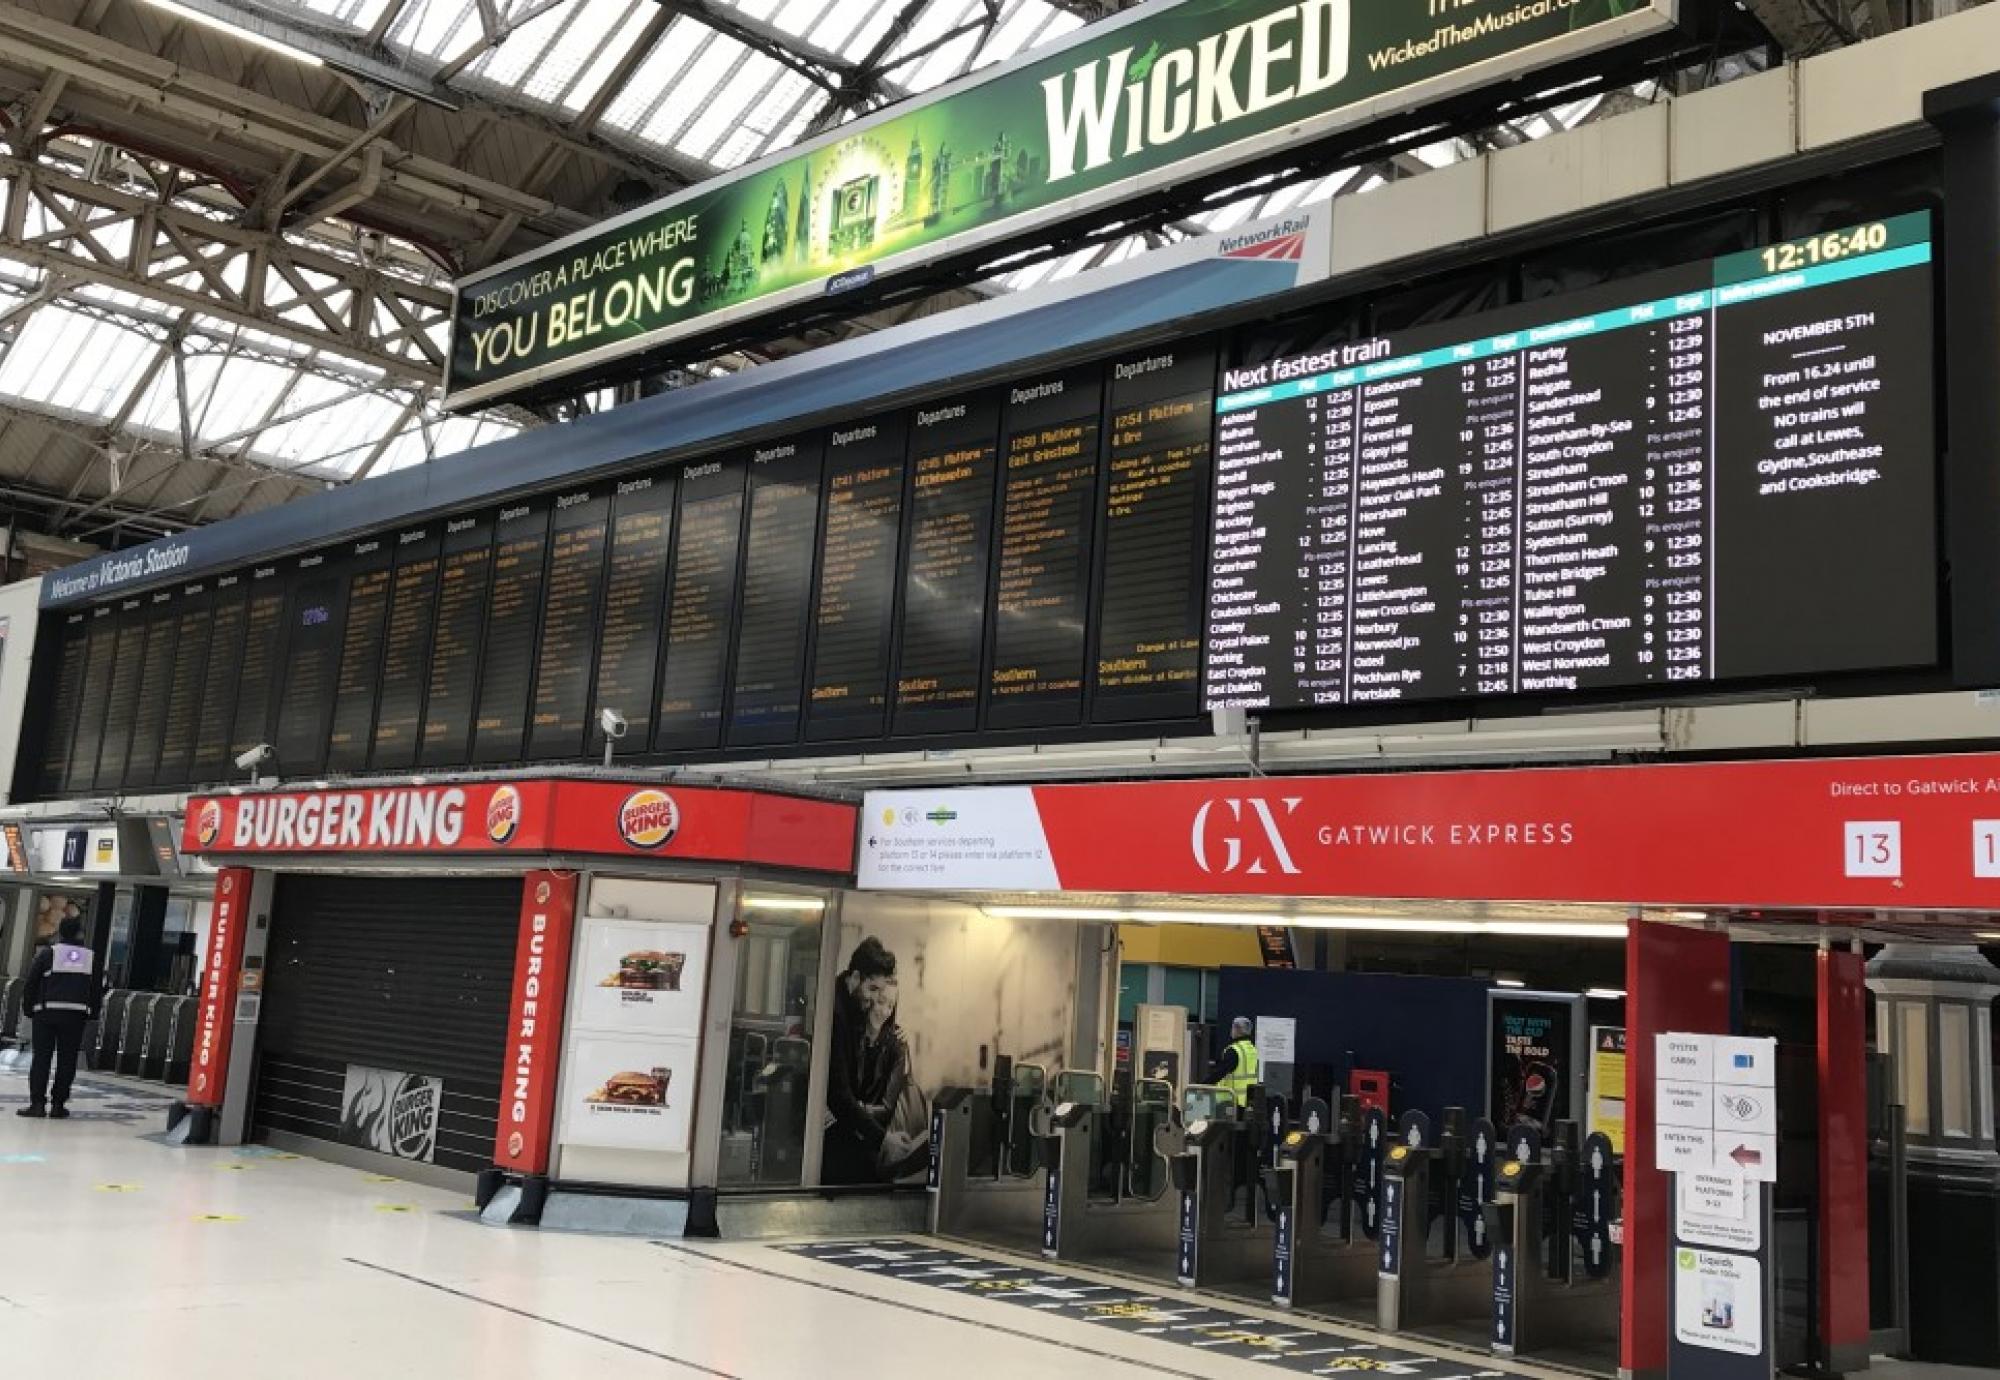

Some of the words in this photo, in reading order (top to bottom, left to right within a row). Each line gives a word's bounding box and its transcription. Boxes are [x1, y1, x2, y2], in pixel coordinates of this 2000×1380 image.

[1762, 223, 1887, 272] 12:16:40
[474, 273, 553, 319] DISCOVER
[554, 268, 566, 288] A
[572, 240, 625, 283] PLACE
[630, 214, 698, 258] WHERE
[472, 311, 537, 372] YOU
[547, 257, 695, 347] BELONG
[1763, 317, 1843, 346] NOVEMBER
[1846, 312, 1875, 331] 5TH
[1223, 368, 1267, 392] Next
[1272, 349, 1338, 379] fastest
[1342, 337, 1391, 363] train
[1529, 347, 1567, 362] Purley
[1115, 354, 1173, 380] Departures
[1763, 369, 1800, 388] From
[1803, 360, 1841, 380] 16.24
[1844, 355, 1876, 374] until
[1011, 380, 1063, 404] Departures
[1528, 388, 1601, 414] Sanderstead
[1759, 396, 1781, 410] the
[1783, 390, 1810, 405] end
[1813, 387, 1829, 400] of
[1830, 379, 1881, 397] service
[1364, 397, 1399, 414] Epsom
[1773, 413, 1798, 429] NO
[1799, 405, 1839, 424] trains
[1842, 401, 1865, 417] will
[918, 405, 966, 427] Departures
[833, 426, 877, 447] Departures
[1774, 433, 1798, 450] call
[1800, 432, 1815, 445] at
[1817, 425, 1864, 443] Lewes,
[1527, 449, 1562, 464] South
[1562, 440, 1613, 458] Croydon
[1360, 473, 1410, 492] Haywards
[1411, 468, 1444, 482] Heath
[1526, 463, 1588, 481] Streatham
[1759, 479, 1786, 495] and
[1788, 467, 1881, 491] Cooksbridge.
[1360, 494, 1392, 507] Honor
[1393, 488, 1415, 501] Oak
[1416, 484, 1442, 498] Park
[1526, 498, 1587, 516] Streatham
[1589, 492, 1609, 506] Hill
[1359, 508, 1407, 523] Horsham
[1526, 519, 1564, 533] Sutton
[1565, 509, 1613, 528] (Surrey)
[1358, 527, 1386, 538] Hove
[1525, 533, 1588, 551] Sydenham
[1644, 539, 1654, 552] 9
[1667, 534, 1702, 549] 12:30
[144, 544, 189, 576] Station
[1358, 551, 1423, 571] Leatherhead
[1525, 552, 1580, 567] Thornton
[1581, 544, 1619, 560] Heath
[1667, 552, 1702, 568] 12:35
[1356, 574, 1388, 586] Lewes
[1524, 571, 1559, 584] Three
[1560, 566, 1607, 581] Bridges
[1524, 588, 1555, 601] Tulse
[1557, 585, 1576, 598] Hill
[1644, 595, 1654, 608] 9
[1667, 589, 1702, 604] 12:30
[1356, 608, 1378, 620] New
[1380, 606, 1408, 617] Cross
[1410, 602, 1435, 614] Gate
[1524, 604, 1586, 619] Wallington
[1644, 613, 1654, 626] 9
[1666, 608, 1702, 623] 12:30
[1355, 622, 1399, 635] Norbury
[1644, 631, 1654, 644] 9
[1666, 627, 1702, 642] 12:30
[1354, 637, 1402, 651] Norwood
[1402, 636, 1420, 650] Jcn
[1523, 641, 1552, 654] West
[1554, 637, 1606, 653] Croydon
[1522, 659, 1552, 671] West
[1553, 653, 1610, 669] Norwood
[1638, 650, 1653, 663] 10
[1666, 646, 1701, 661] 12:36
[1354, 671, 1400, 685] Peckham
[1401, 669, 1421, 683] Rye
[1522, 675, 1578, 690] Worthing
[1667, 665, 1701, 680] 12:45
[1352, 687, 1401, 701] Portslade
[1830, 781, 1879, 797] Direct
[1884, 782, 1901, 796] to
[1908, 777, 1979, 795] Gatwick
[234, 793, 363, 847] BURGER
[368, 788, 465, 845] KING
[624, 801, 670, 820] BURGER
[625, 813, 672, 835] KING
[1192, 796, 1303, 874] GX
[1318, 824, 1435, 846] GATWICK
[1450, 822, 1574, 845] EXPRESS
[1855, 833, 1891, 864] 13
[1985, 833, 1995, 864] 1
[520, 914, 546, 1038] BURGER
[1524, 1046, 1549, 1057] BOLD
[1670, 1056, 1696, 1066] CARDS
[512, 1044, 531, 1122] KING
[395, 1107, 432, 1141] KING
[1700, 1253, 1734, 1267] Liquids
